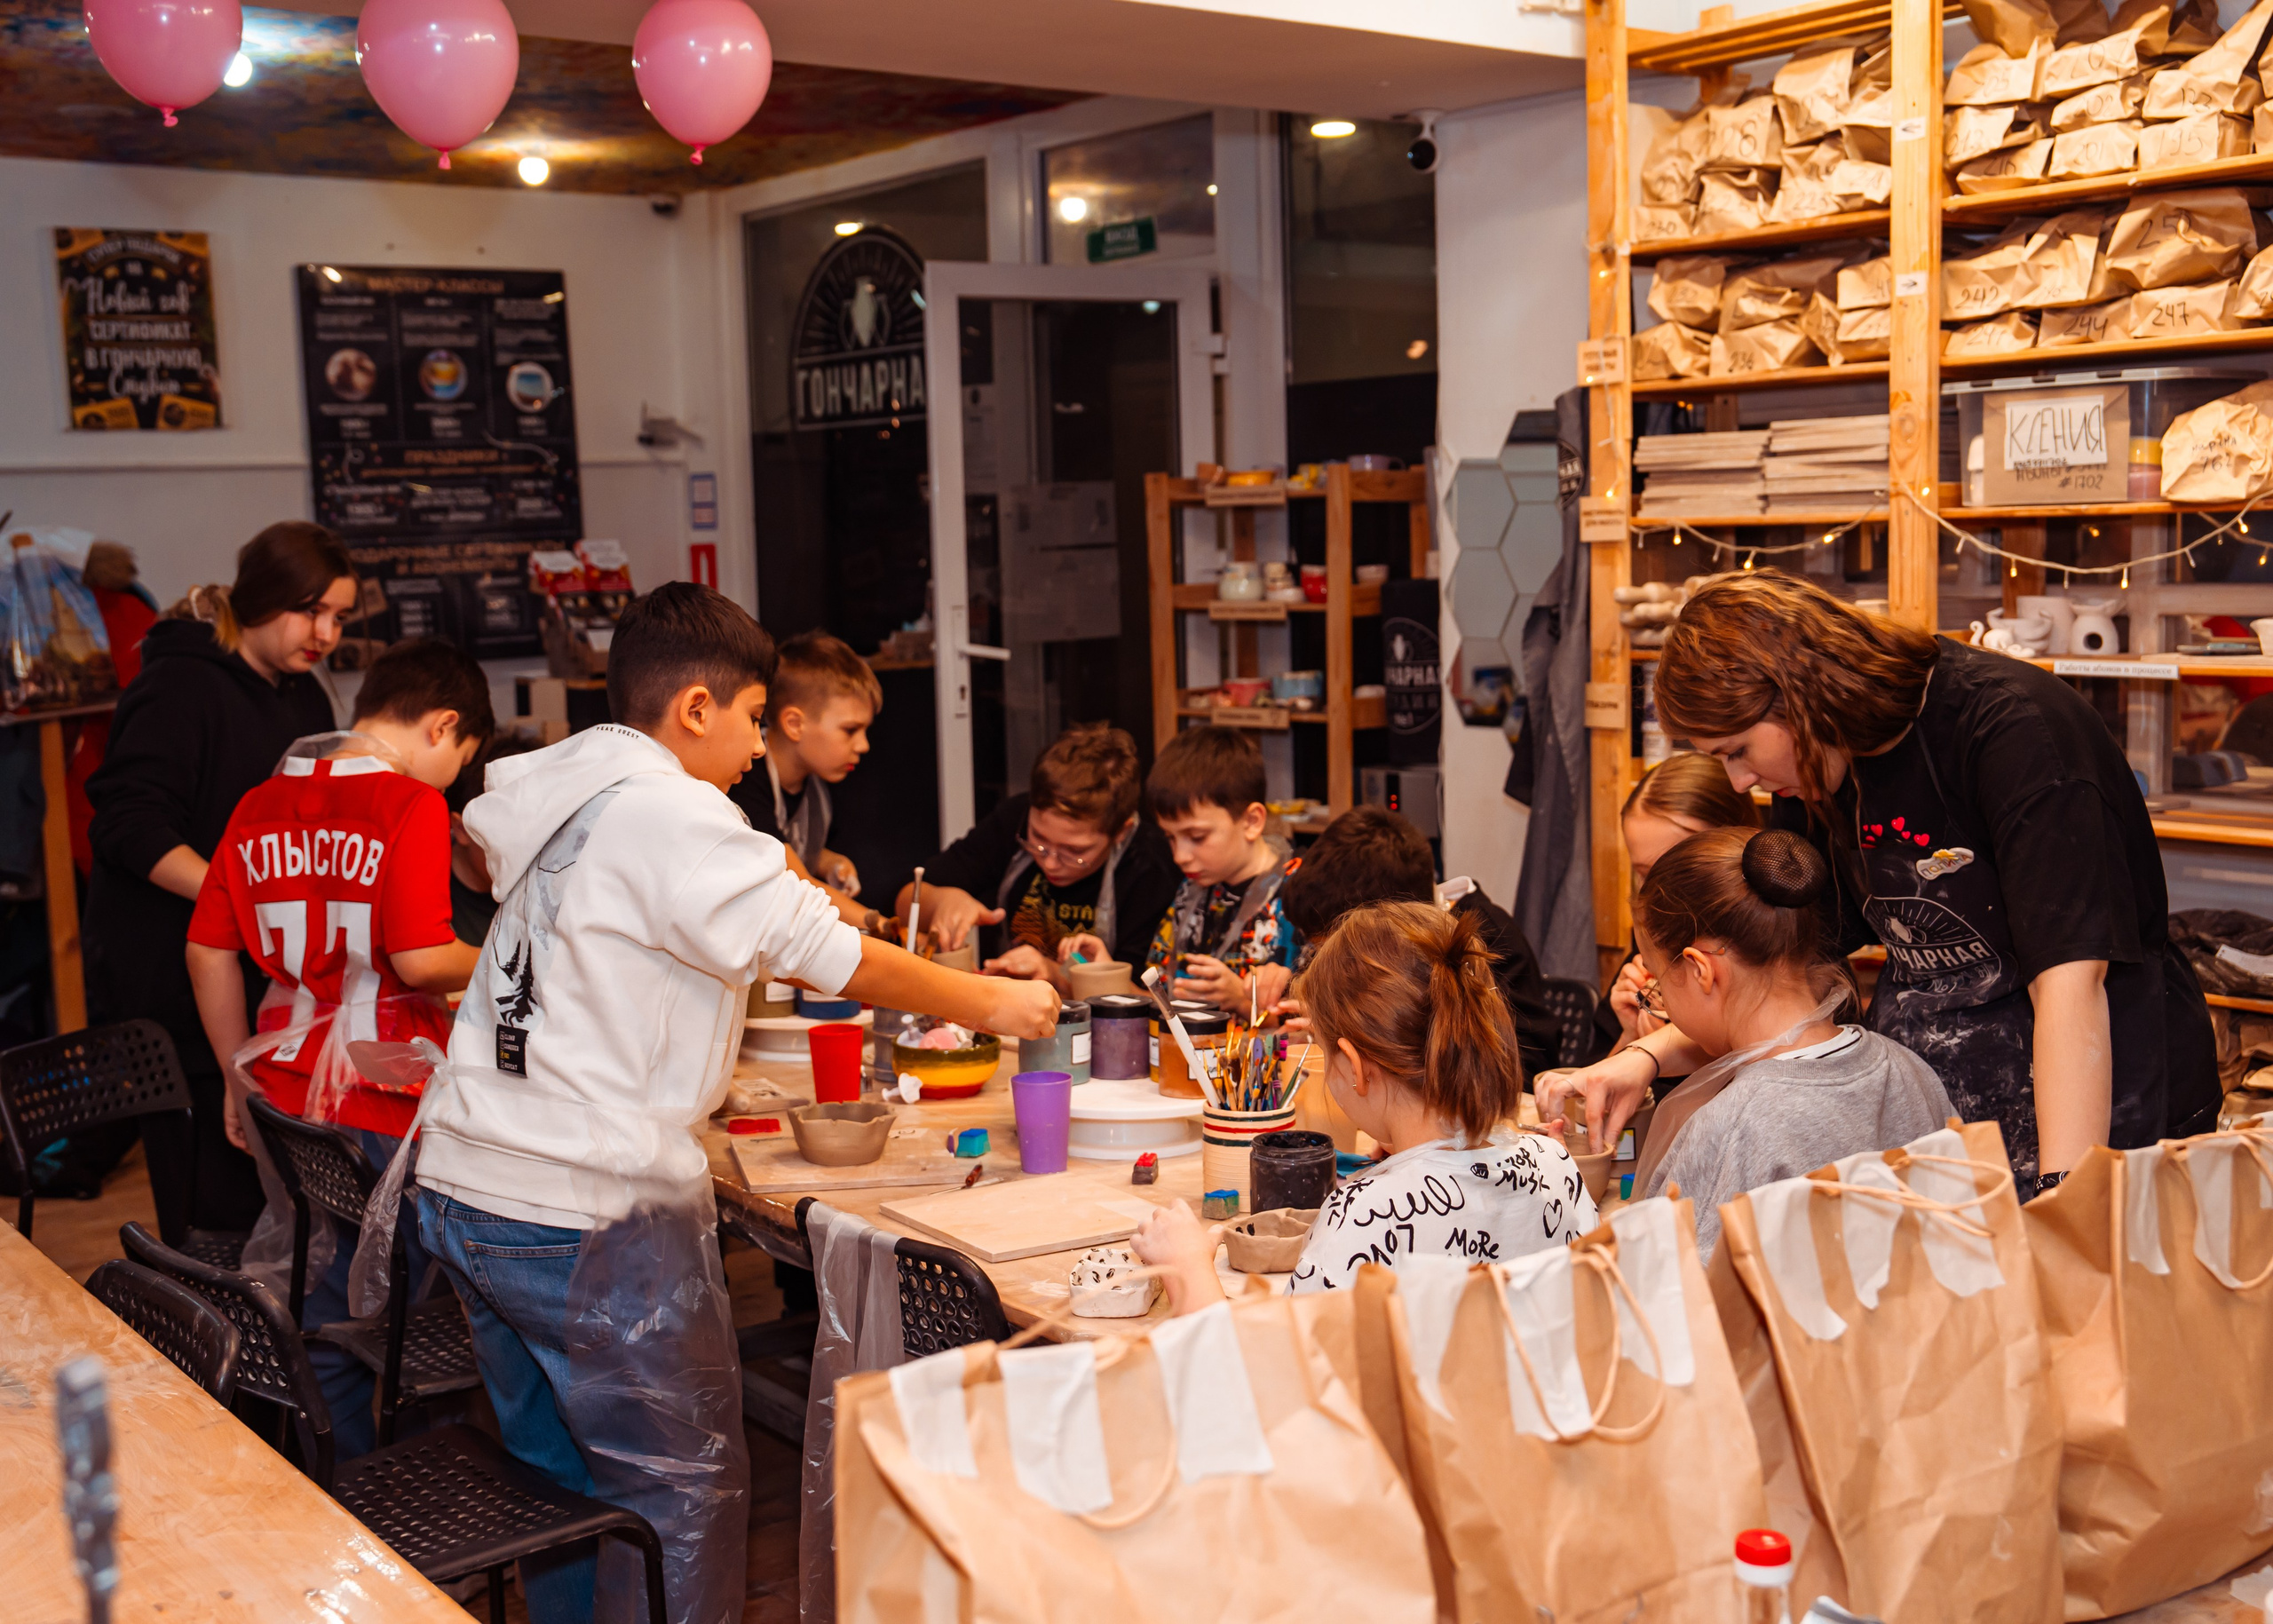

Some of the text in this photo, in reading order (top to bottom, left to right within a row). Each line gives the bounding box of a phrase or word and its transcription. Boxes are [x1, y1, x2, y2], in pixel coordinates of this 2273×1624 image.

[2063, 315, 2109, 339] 244
[2151, 301, 2190, 327] 247
[2008, 404, 2103, 458] КСЕНИЯ
[2059, 661, 2090, 672] Работы
[237, 828, 385, 886] ХЛЫСТОВ
[254, 899, 382, 1062] 77
